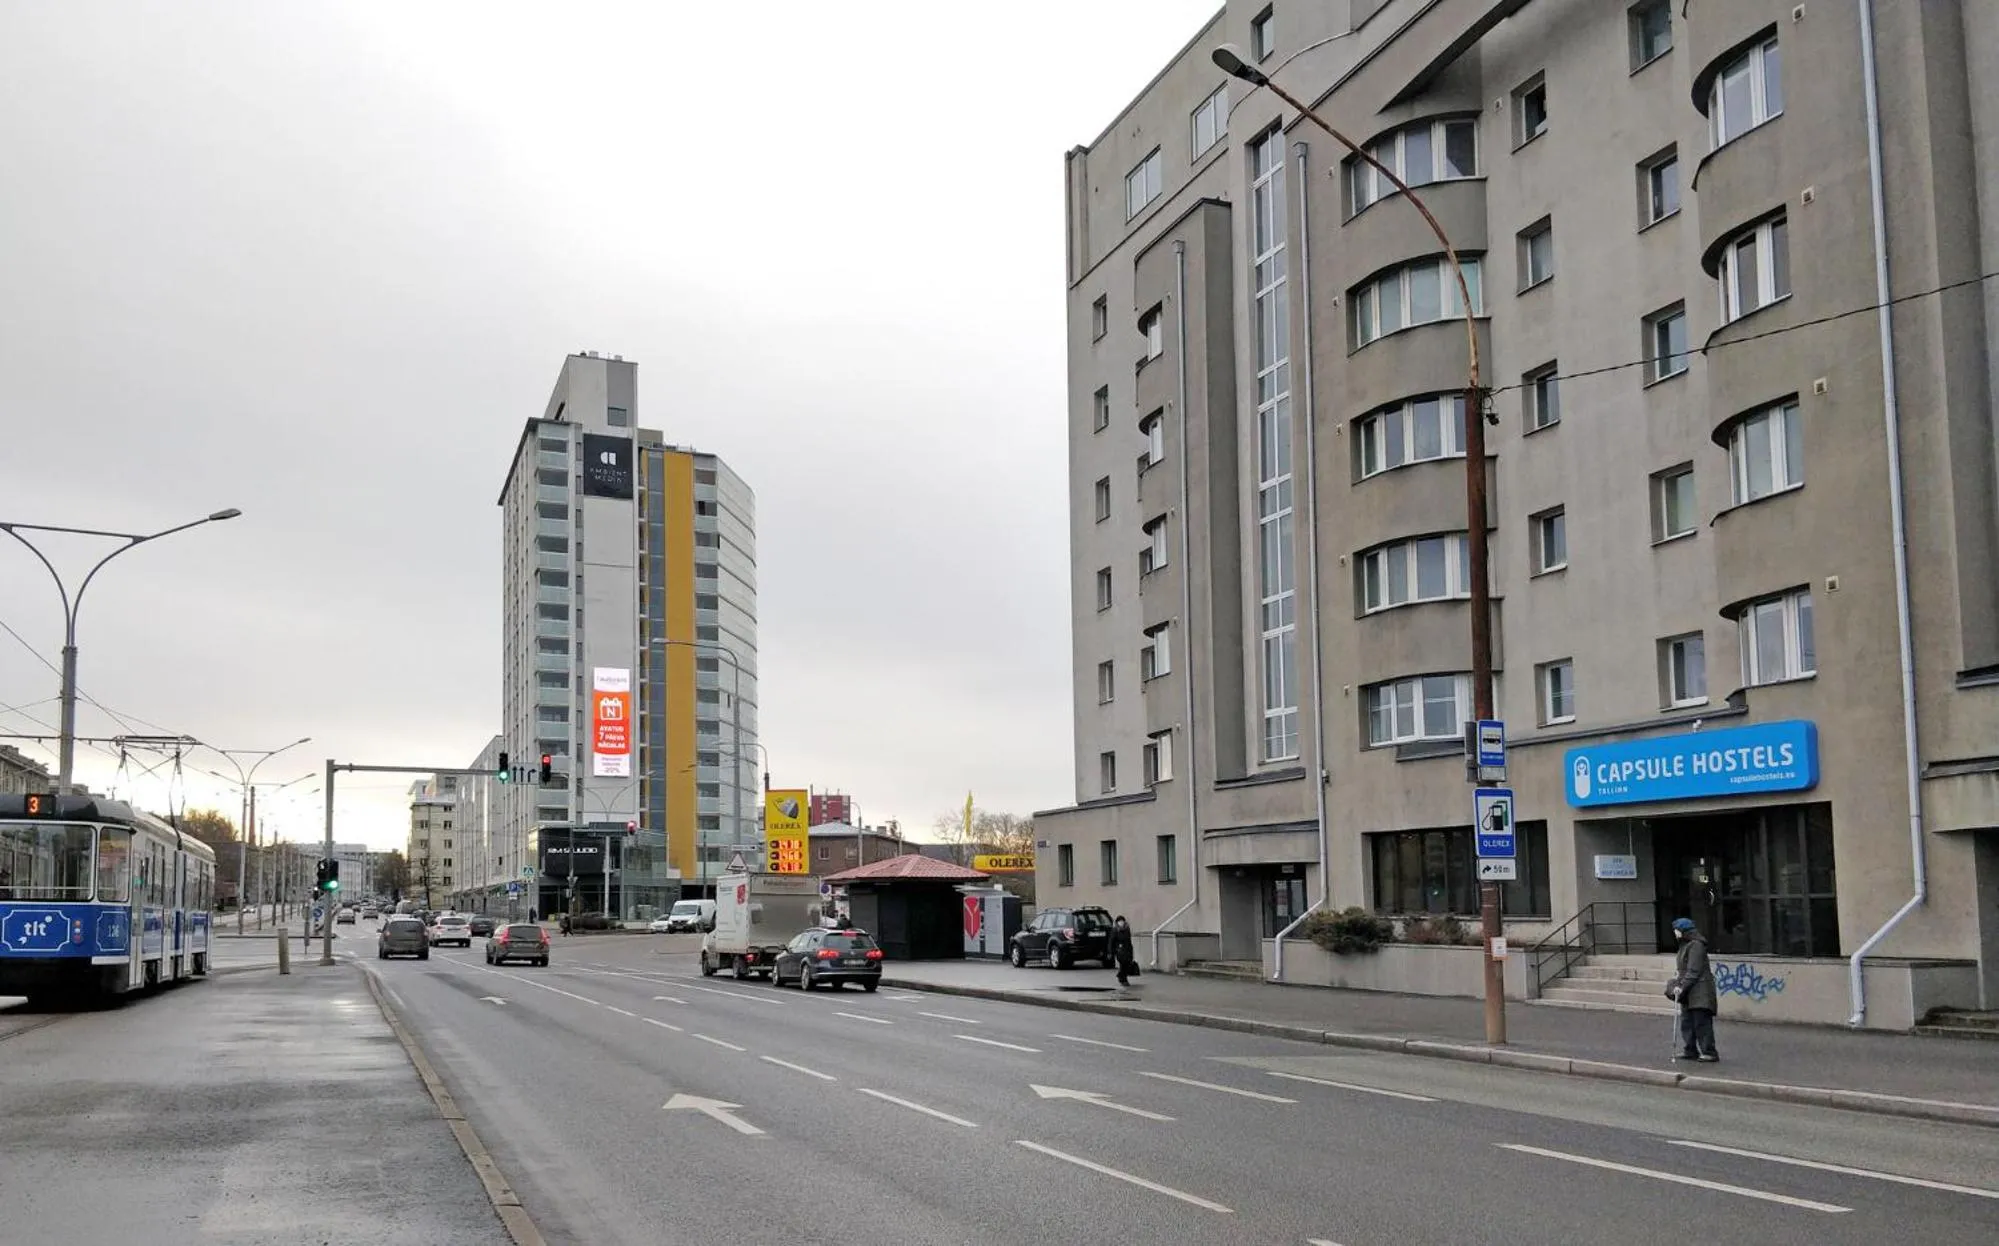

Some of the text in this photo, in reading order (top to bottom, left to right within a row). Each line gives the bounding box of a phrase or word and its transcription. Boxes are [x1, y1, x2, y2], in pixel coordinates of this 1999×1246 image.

[1597, 743, 1794, 784] CAPSULE HOSTELS
[28, 796, 39, 813] 3
[1482, 839, 1511, 848] OLEREX
[989, 857, 1034, 868] OLEREX
